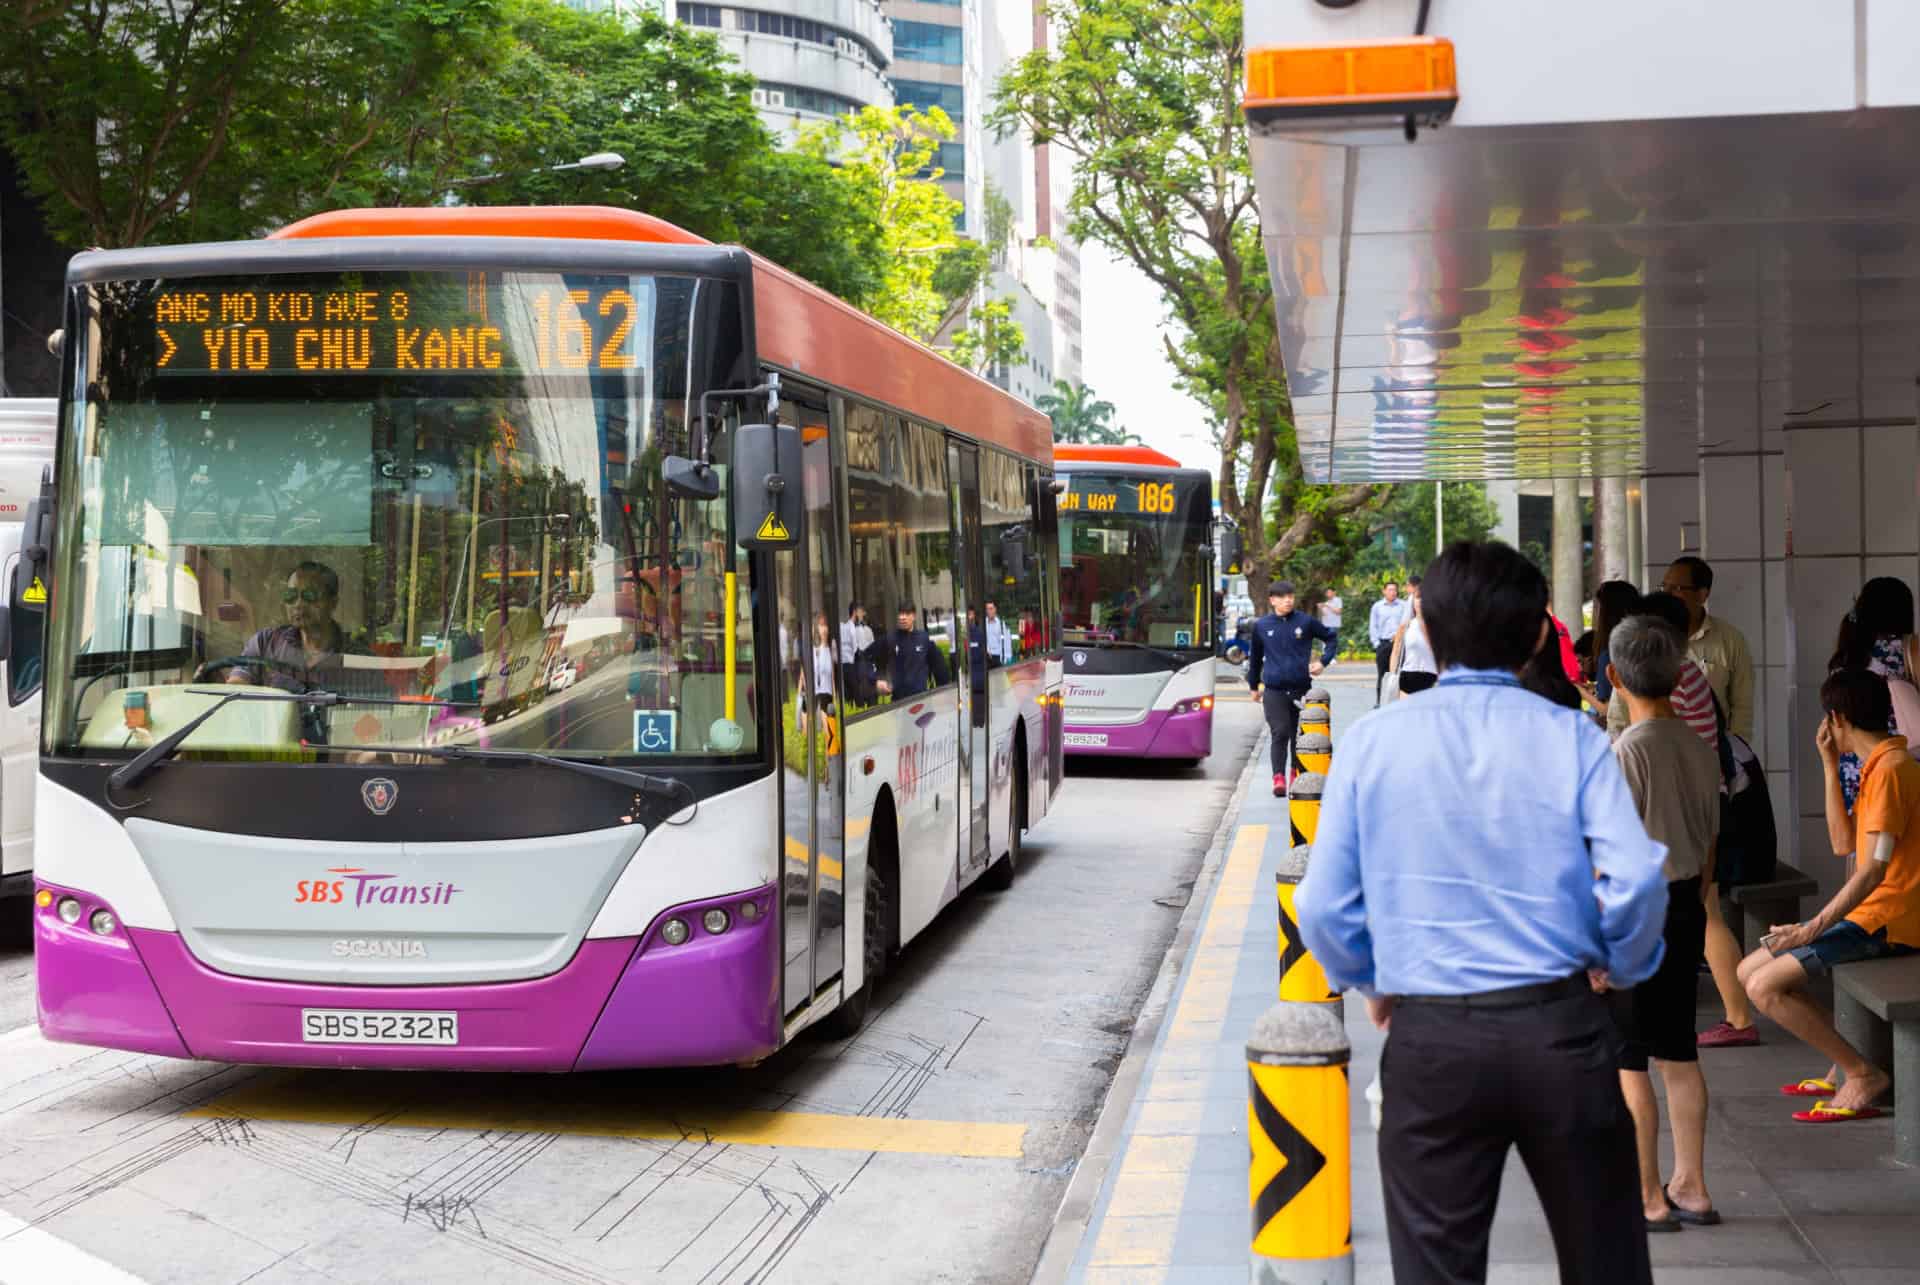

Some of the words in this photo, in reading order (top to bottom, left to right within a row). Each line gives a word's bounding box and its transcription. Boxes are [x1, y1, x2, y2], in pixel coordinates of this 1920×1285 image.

[156, 293, 209, 322] ANG
[221, 293, 257, 321] MO
[269, 293, 313, 321] KIO
[325, 293, 379, 321] AVE
[391, 292, 409, 321] 8
[534, 290, 638, 369] 162
[203, 329, 270, 370] YIO
[296, 329, 369, 369] CHU
[396, 328, 502, 369] KANG
[1087, 494, 1117, 512] WAY
[1138, 482, 1175, 513] 186
[1069, 685, 1106, 697] Transit
[1064, 735, 1107, 745] S8922M
[295, 880, 344, 903] SBS
[342, 874, 463, 909] Transit
[332, 939, 427, 957] SCANIA
[307, 1014, 454, 1039] SBS5232R
